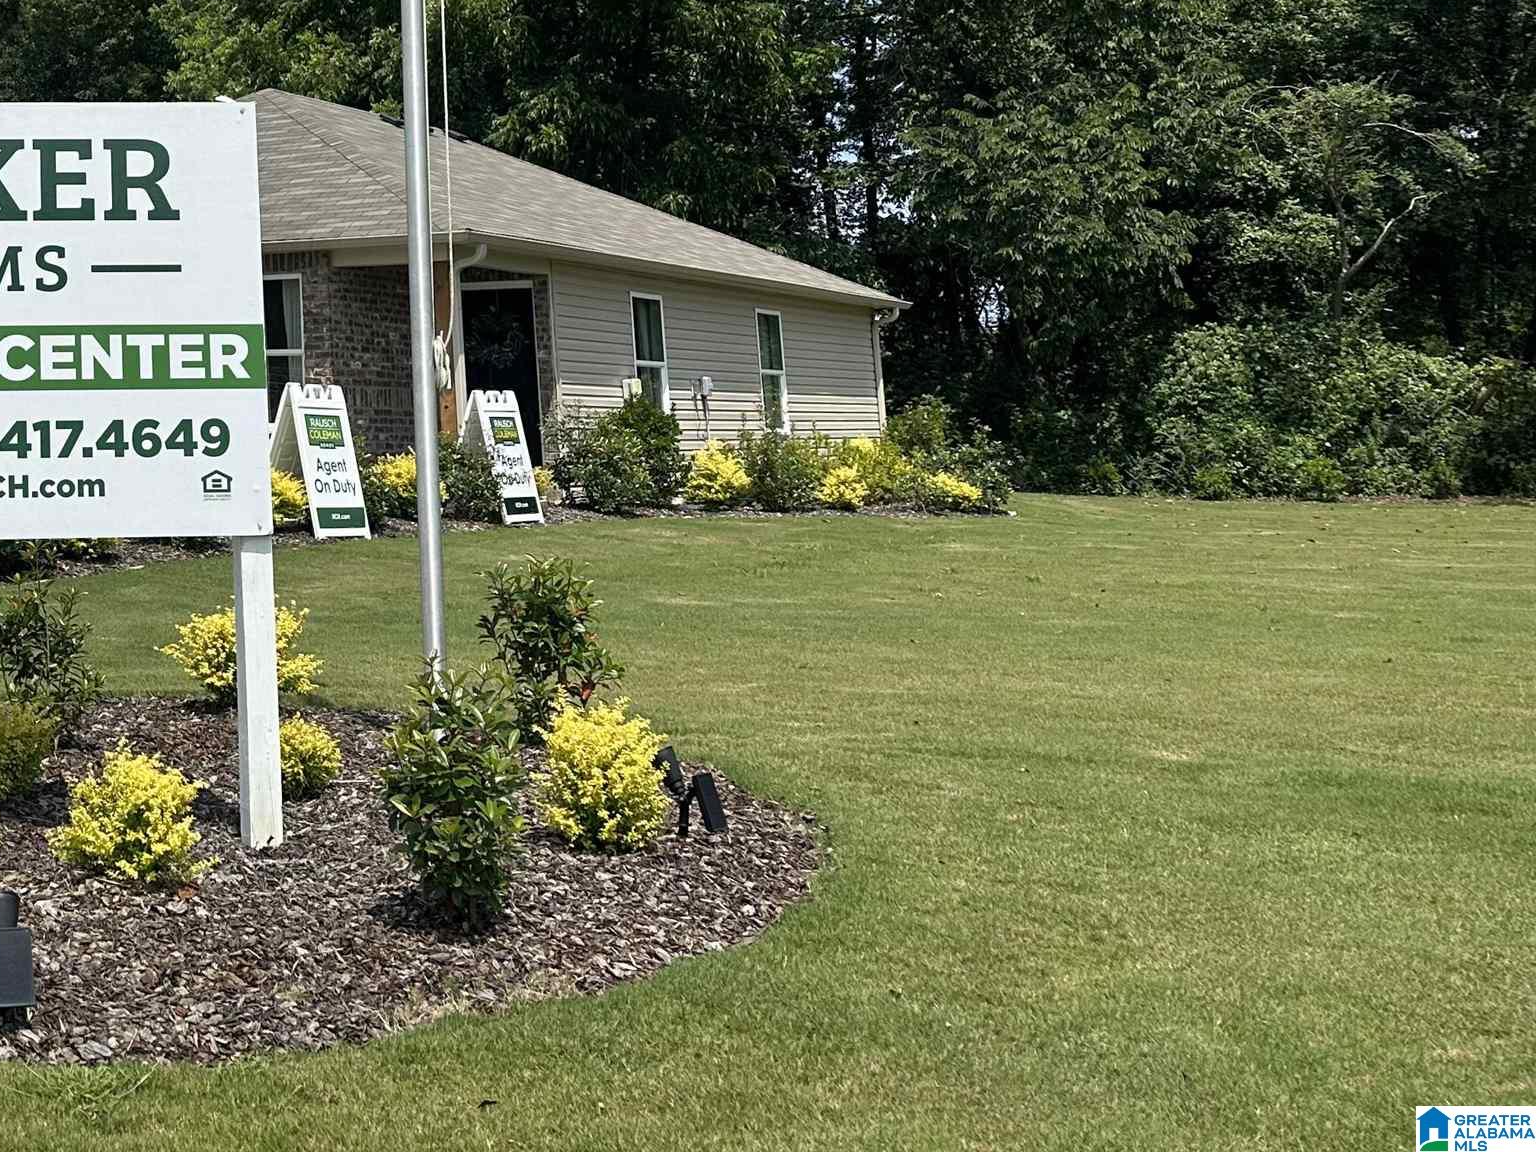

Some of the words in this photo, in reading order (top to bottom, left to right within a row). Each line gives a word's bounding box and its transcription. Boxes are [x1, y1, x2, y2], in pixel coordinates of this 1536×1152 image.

[316, 457, 348, 476] Agent
[314, 478, 331, 494] On
[332, 478, 356, 497] Duty
